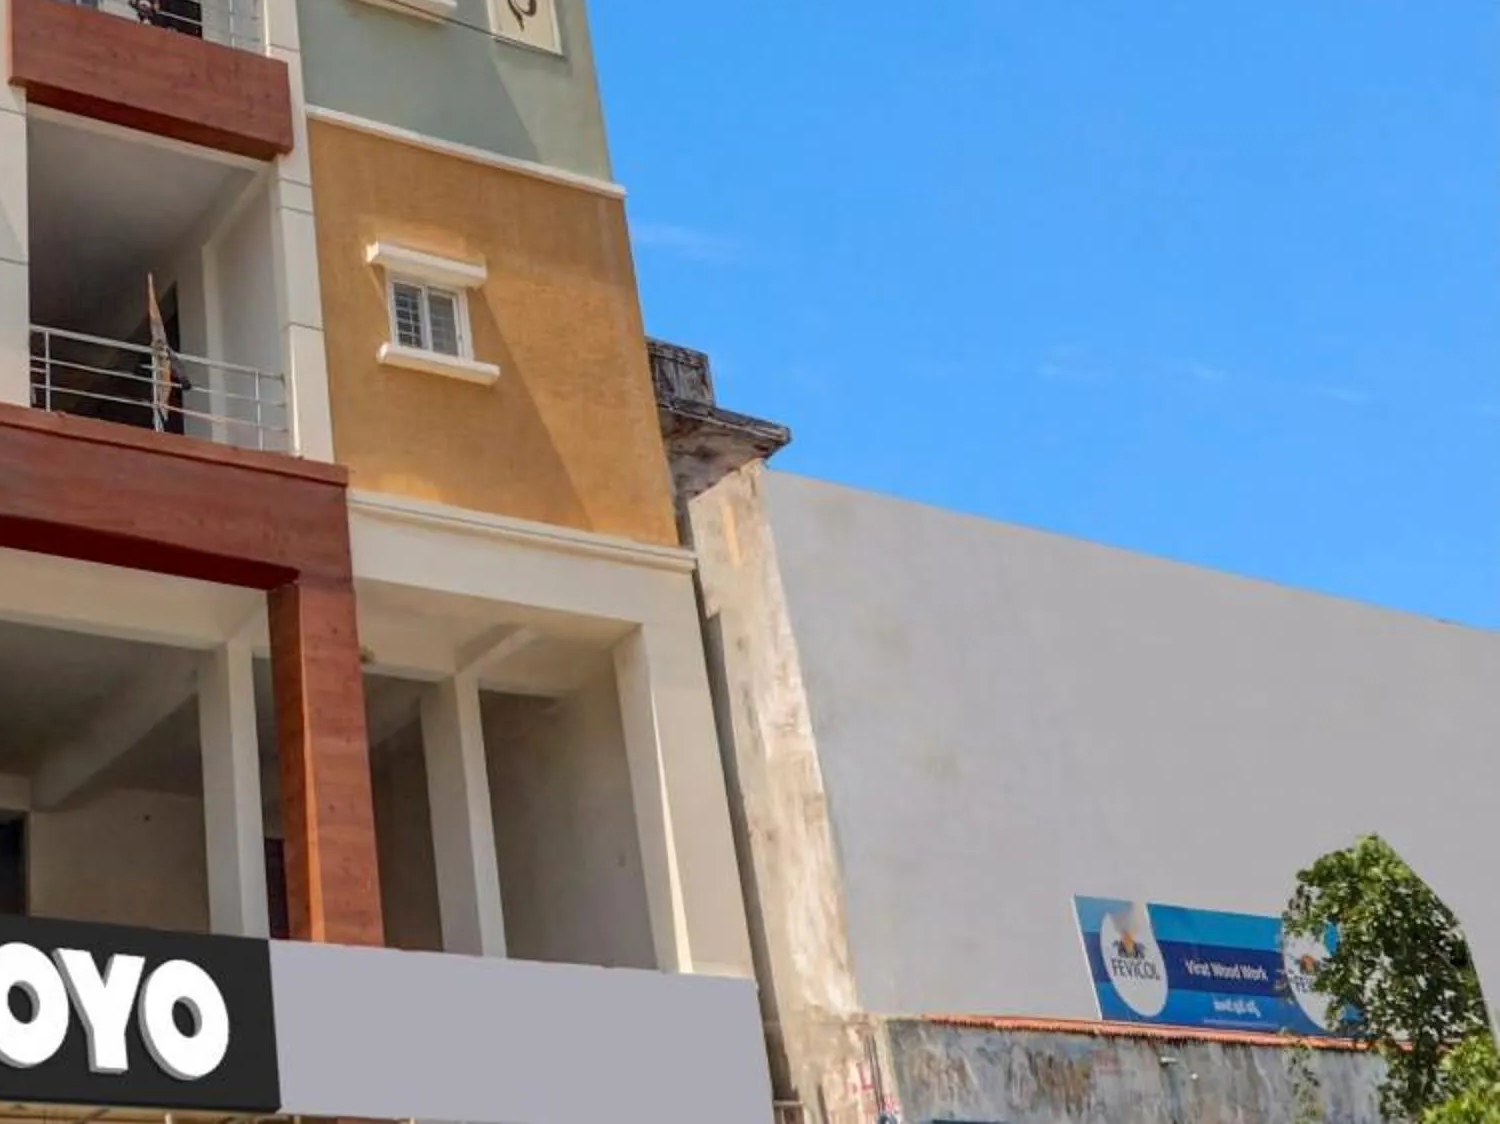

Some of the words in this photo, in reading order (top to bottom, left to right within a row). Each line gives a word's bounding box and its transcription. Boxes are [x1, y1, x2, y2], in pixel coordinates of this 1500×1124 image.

[1111, 958, 1161, 981] FEVICOL
[1211, 962, 1240, 979] Wood
[1241, 964, 1268, 981] Work
